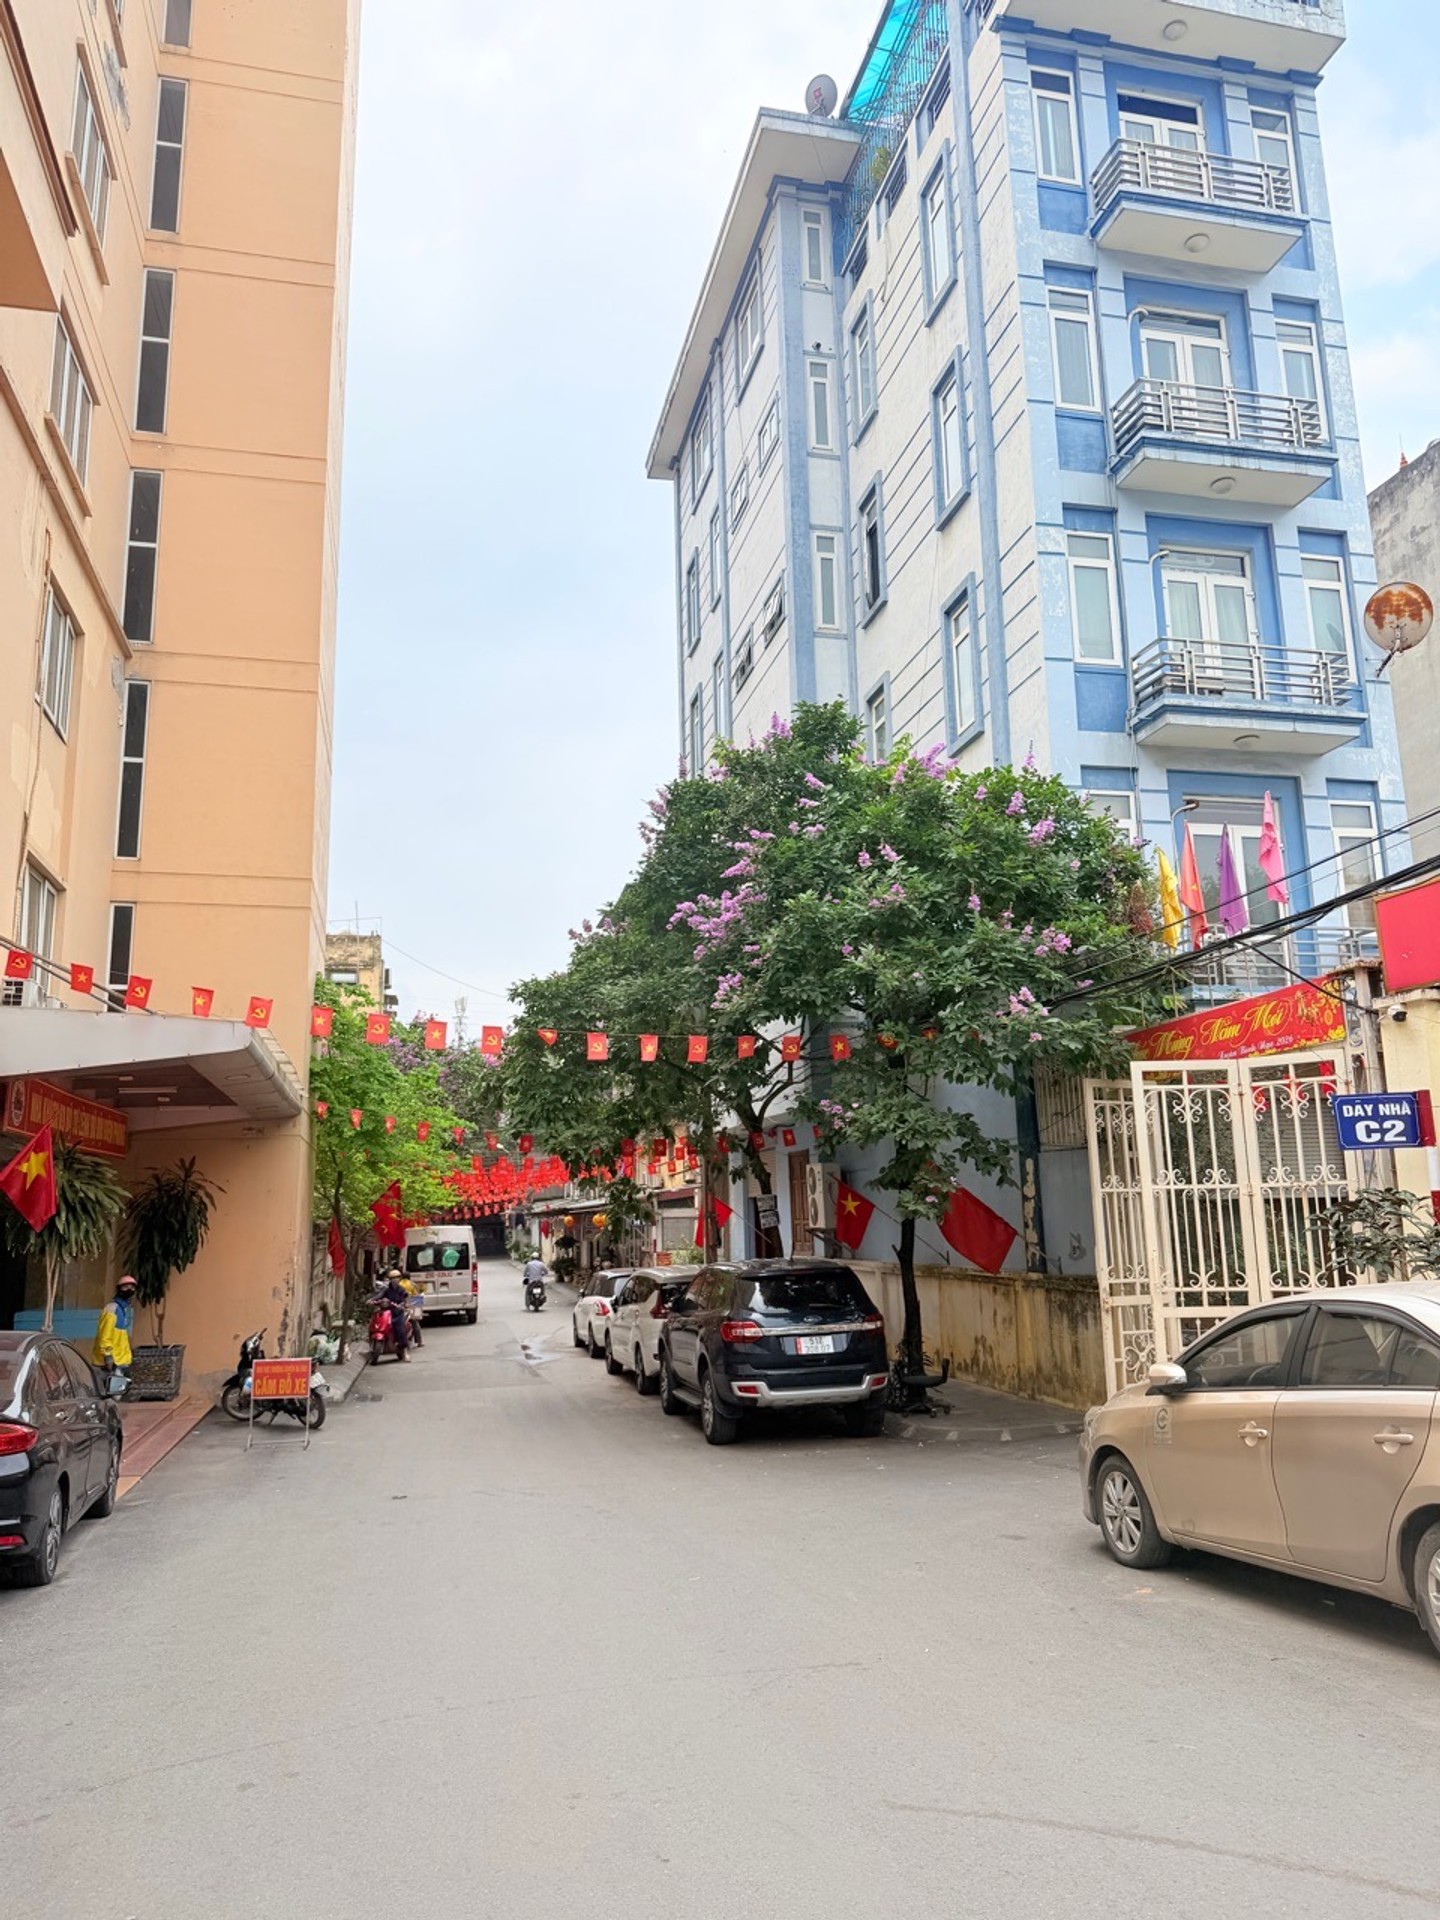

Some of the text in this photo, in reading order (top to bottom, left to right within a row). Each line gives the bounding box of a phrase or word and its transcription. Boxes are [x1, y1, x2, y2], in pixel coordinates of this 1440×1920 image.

[1201, 1014, 1242, 1047] Năm
[1243, 998, 1291, 1036] Mới
[1275, 1034, 1295, 1047] 2026
[1342, 1100, 1412, 1117] DÃY NHÀ
[1355, 1120, 1407, 1143] C2
[255, 1376, 277, 1395] CẤM
[294, 1378, 307, 1394] XE
